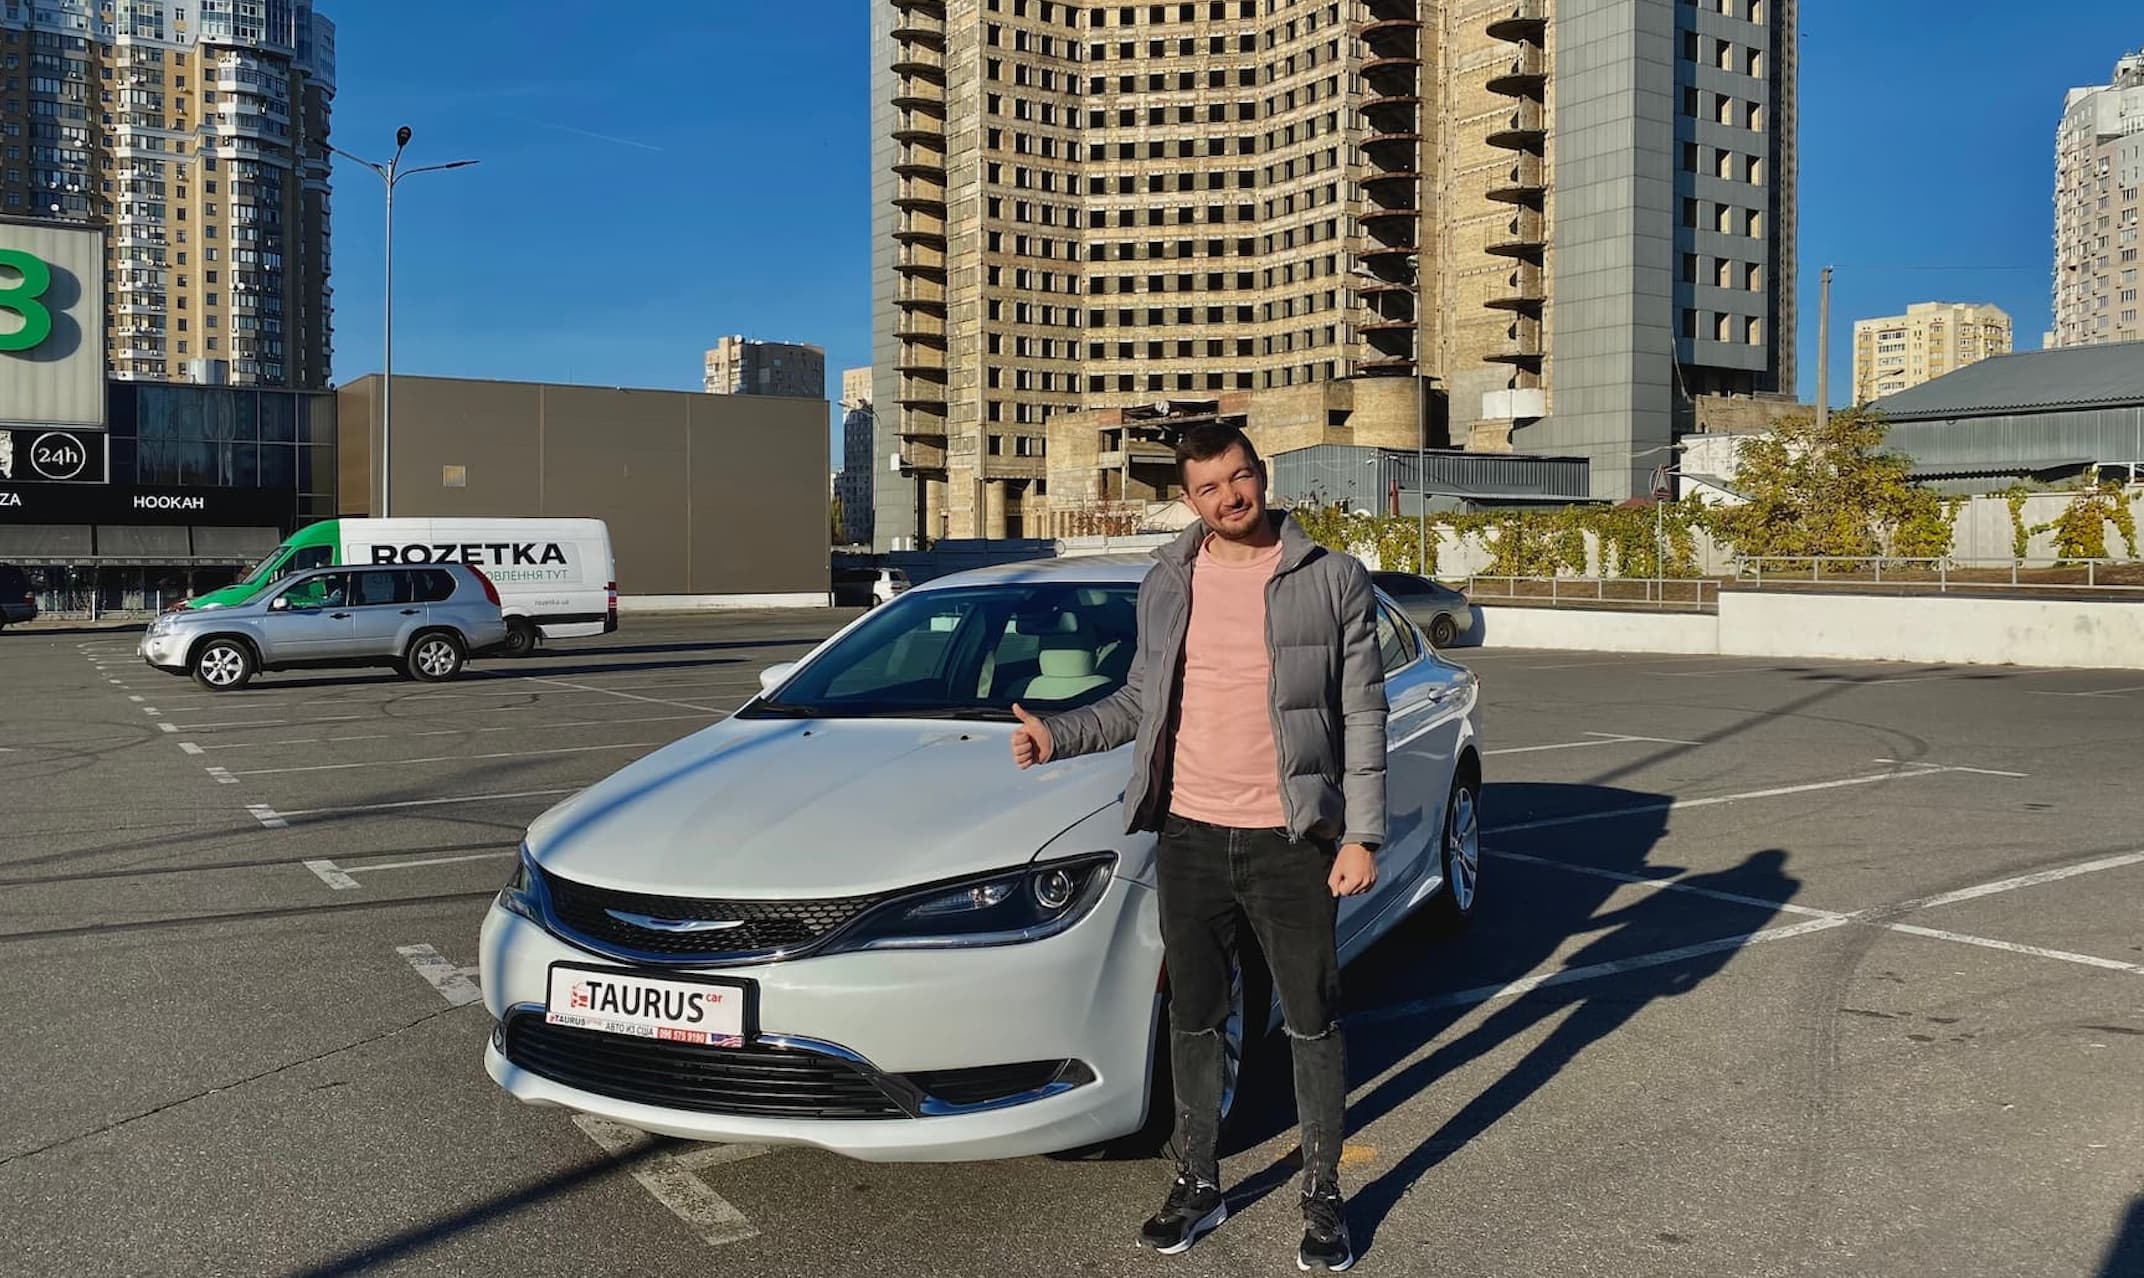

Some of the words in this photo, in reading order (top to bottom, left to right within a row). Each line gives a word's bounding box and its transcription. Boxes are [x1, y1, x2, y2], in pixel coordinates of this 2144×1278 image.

[38, 446, 78, 466] 24h
[133, 495, 205, 510] HOOKAH
[371, 542, 568, 566] ROZETKA
[545, 569, 568, 580] ТУТ
[586, 980, 705, 1023] TAURUS
[705, 993, 724, 1004] car
